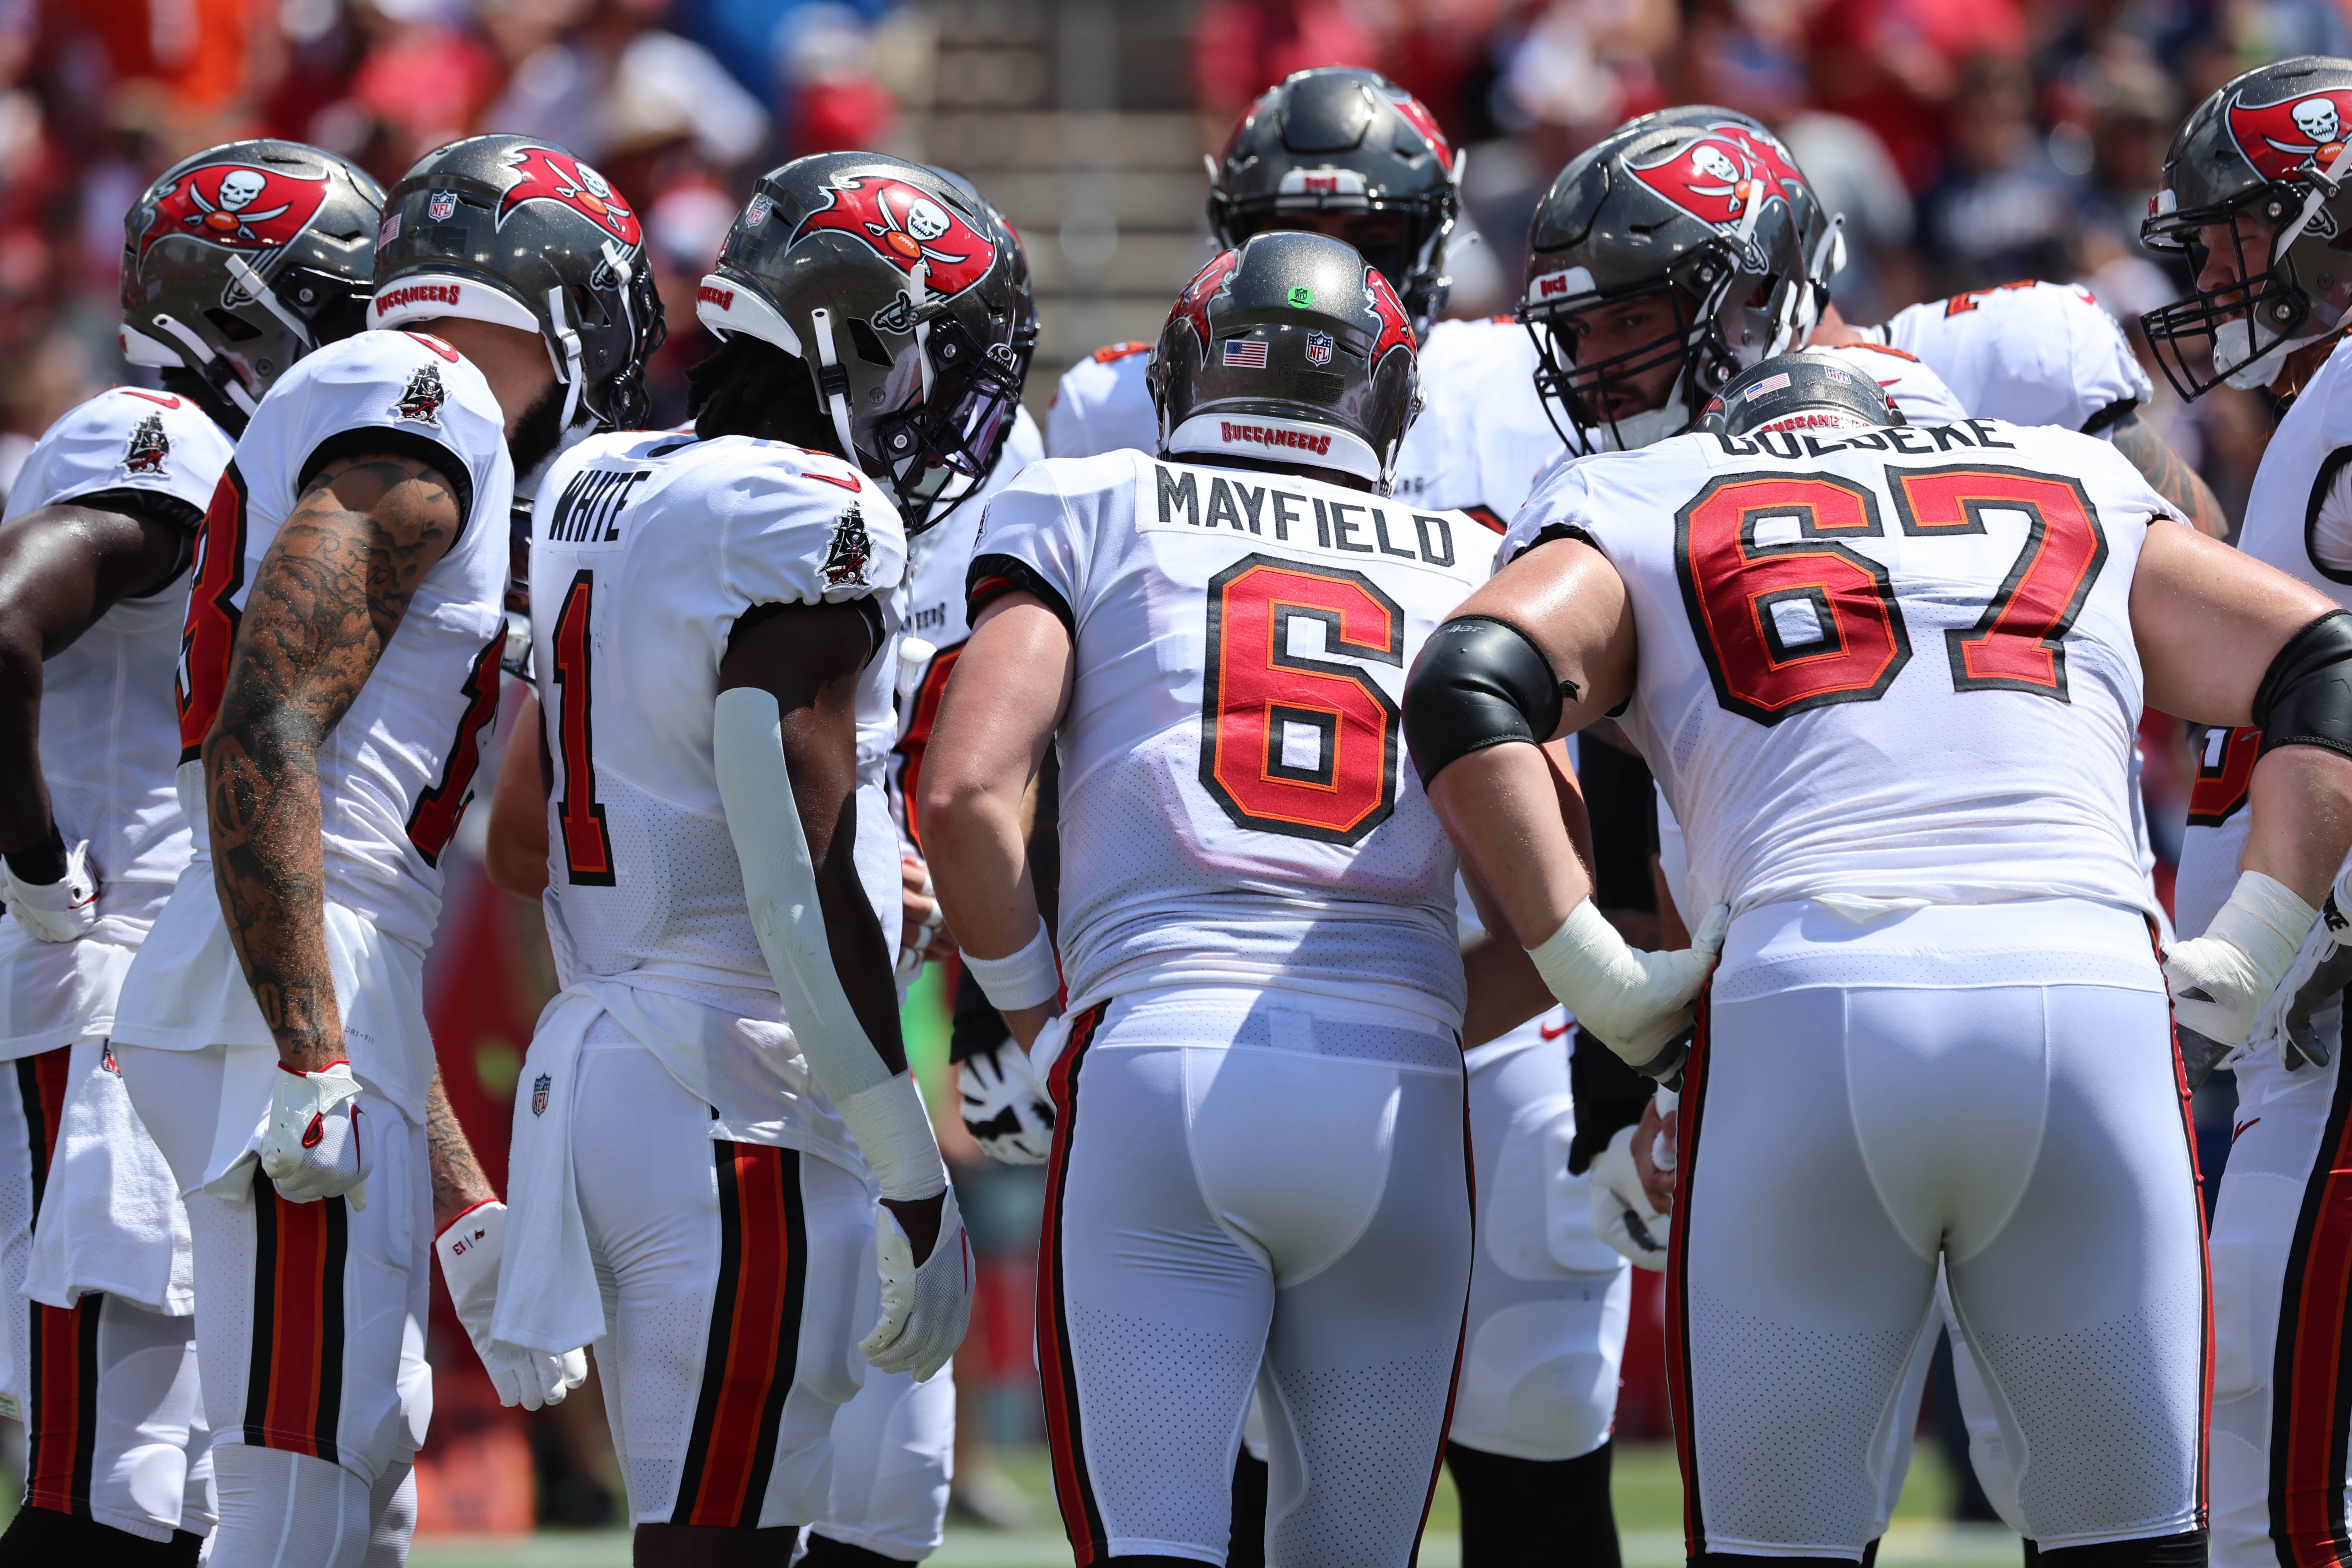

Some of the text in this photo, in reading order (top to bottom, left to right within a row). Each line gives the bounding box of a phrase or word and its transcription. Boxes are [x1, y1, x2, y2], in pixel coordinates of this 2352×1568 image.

[432, 204, 450, 216] NFL
[748, 209, 763, 223] NFL
[376, 285, 460, 317] BUCCANEERS
[1309, 346, 1328, 361] NFL
[1830, 373, 1848, 382] NFL
[1220, 422, 1332, 456] BUCCANEERS
[549, 470, 652, 542] WHITE
[1155, 464, 1455, 567] MAYFIELD
[1675, 463, 2109, 728] 67
[1199, 552, 1404, 847] 6
[553, 569, 616, 887] 1
[534, 1092, 546, 1113] NFL
[453, 1241, 466, 1256] 13
